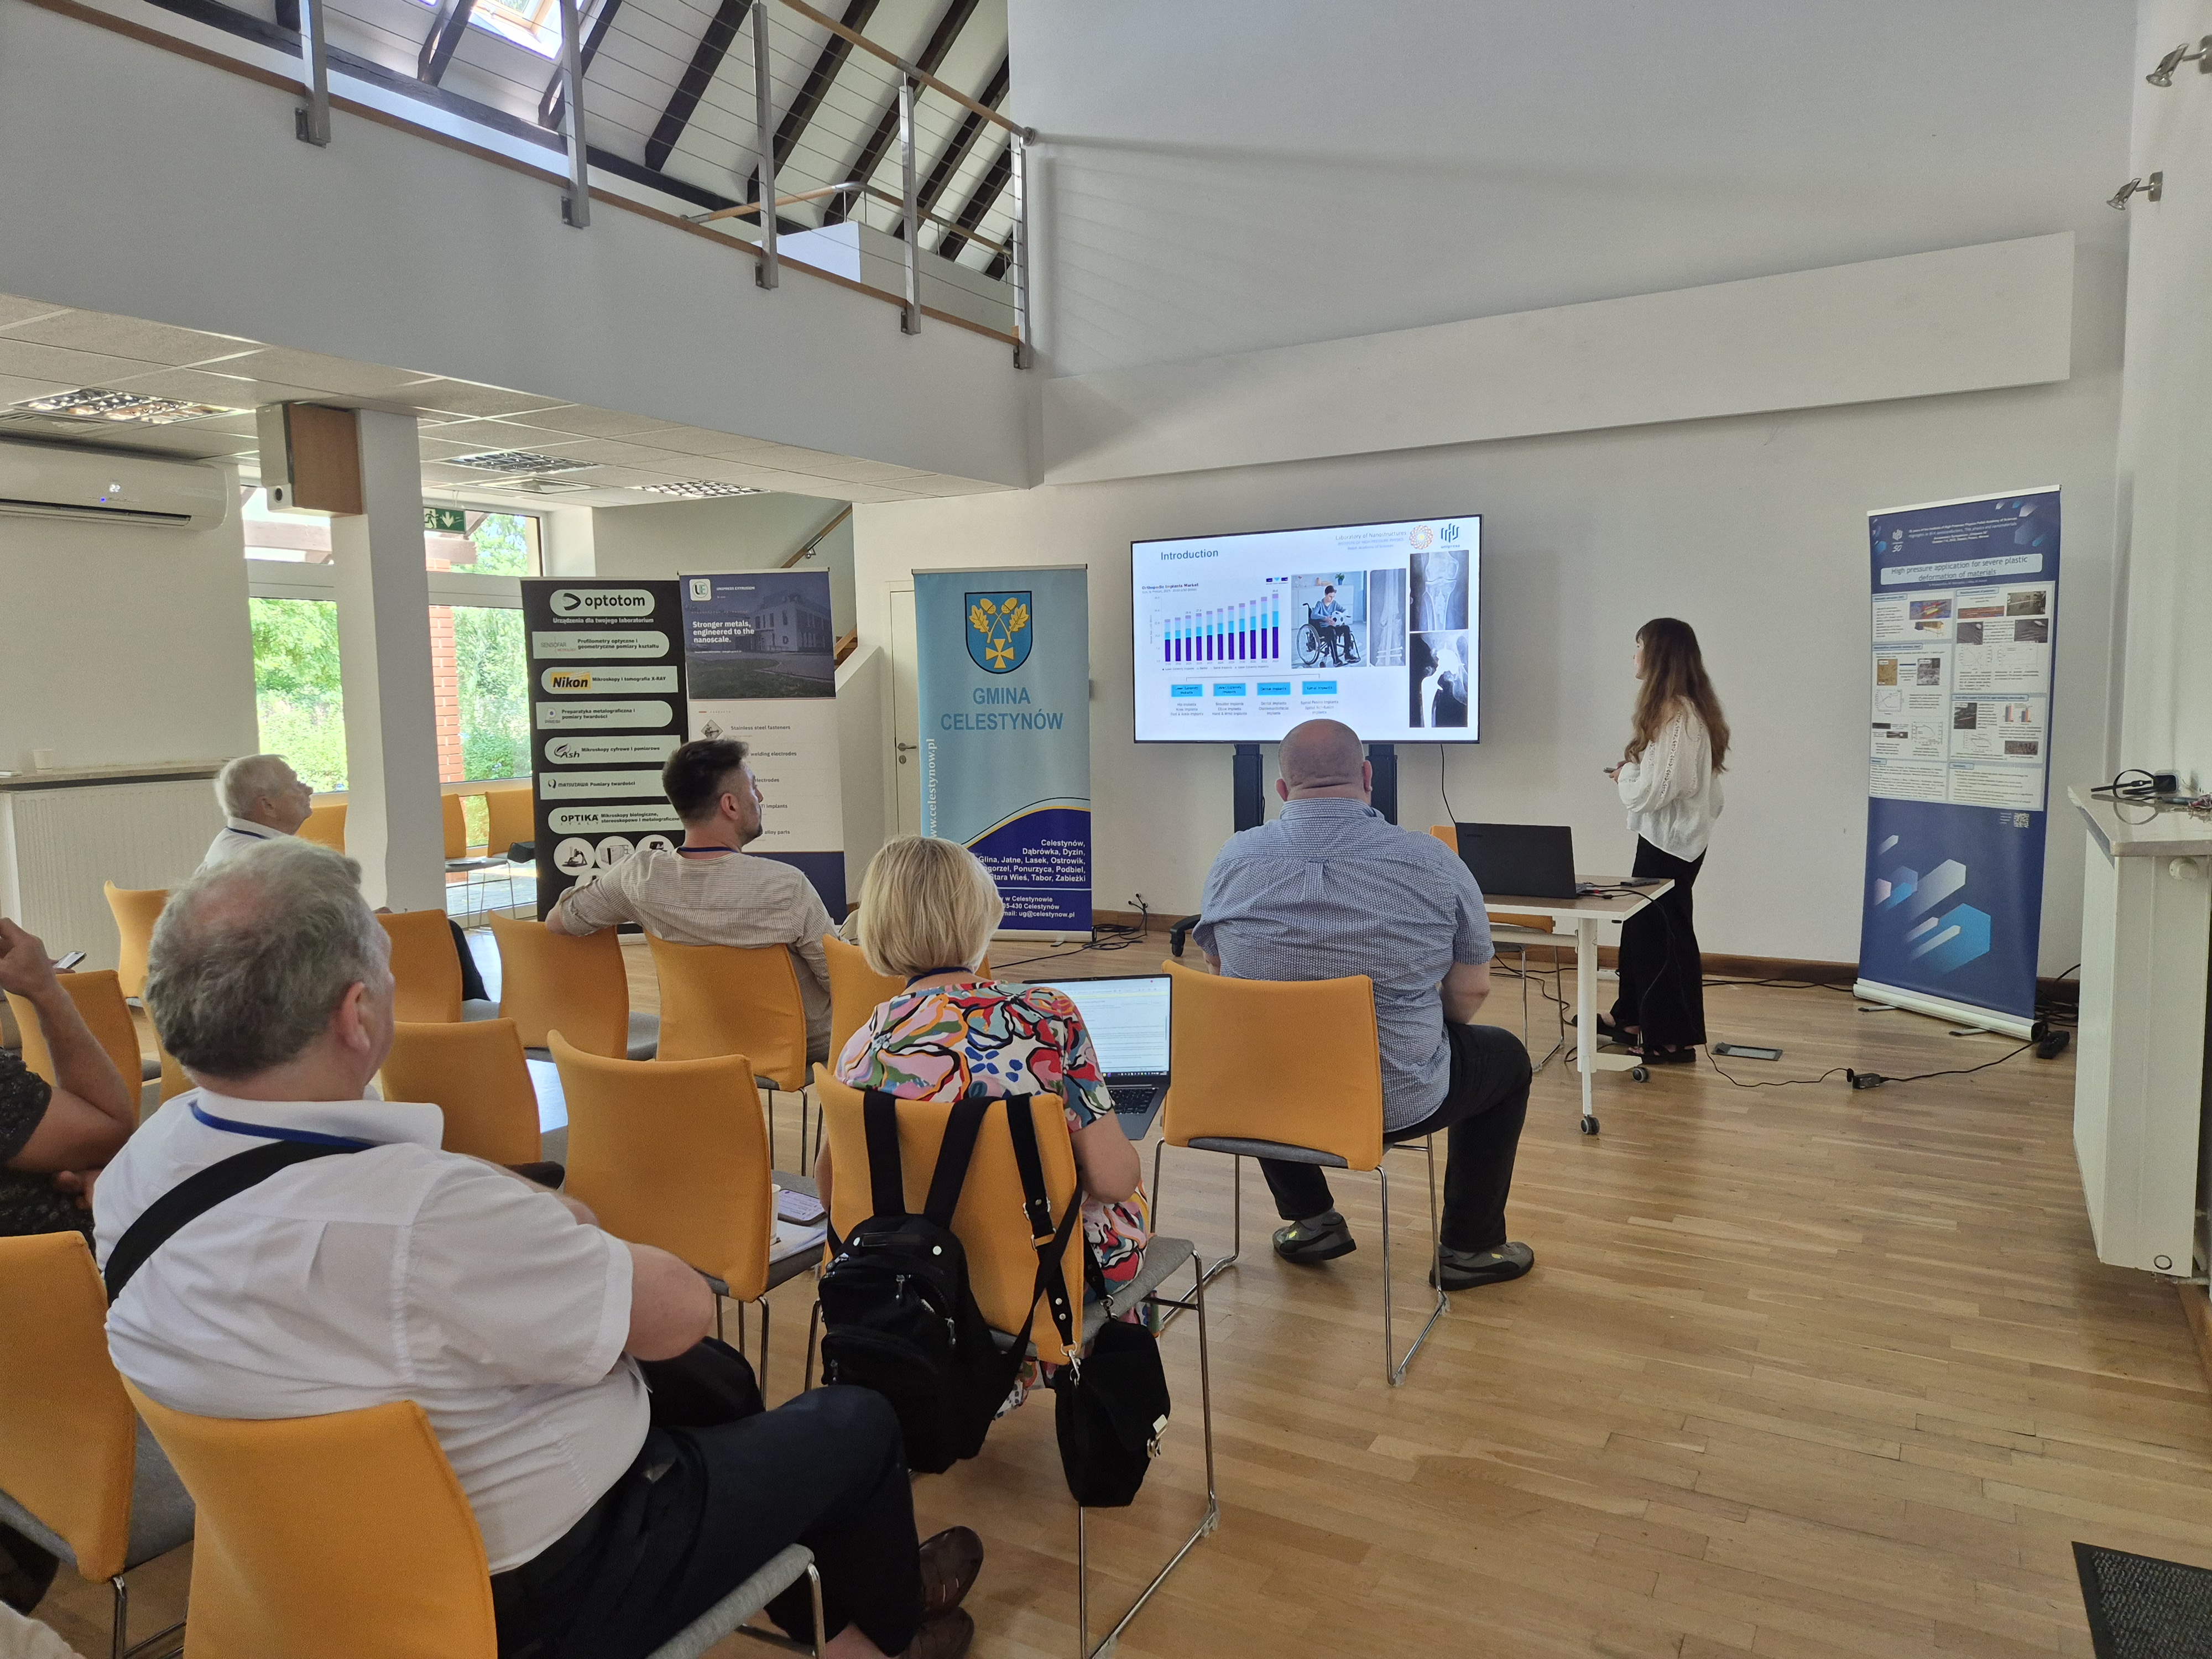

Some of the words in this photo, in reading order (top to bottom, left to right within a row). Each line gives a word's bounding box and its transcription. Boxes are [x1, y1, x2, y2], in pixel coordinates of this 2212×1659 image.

[1161, 549, 1218, 560] Introduction
[1907, 566, 1933, 574] pressure
[1934, 562, 1970, 572] application
[2005, 556, 2028, 566] plastic
[1919, 572, 1957, 581] deformation
[1967, 568, 1996, 577] materials
[585, 595, 645, 609] optotom
[553, 677, 588, 687] Nikon
[973, 687, 1031, 705] GMINA
[941, 708, 1063, 731] CELESTYNÓW
[926, 738, 938, 837] ww.celestynow.pl
[1041, 839, 1085, 848] Celestynów,
[1022, 848, 1061, 856] Dąbrówka,
[1063, 848, 1086, 857] Dyzin,
[1051, 857, 1086, 865] Ostrowik,
[1056, 865, 1086, 874] Podbiel,
